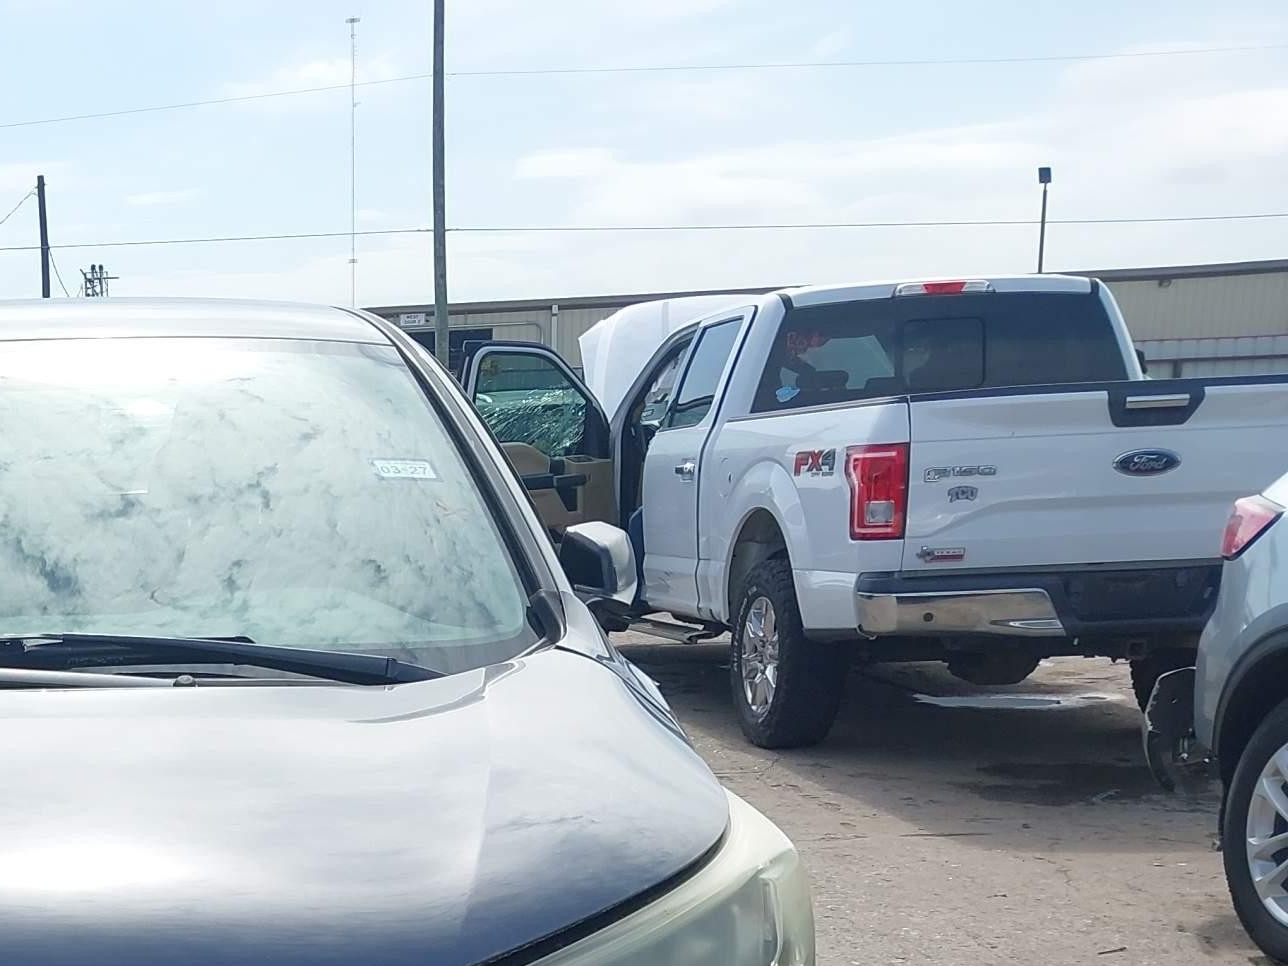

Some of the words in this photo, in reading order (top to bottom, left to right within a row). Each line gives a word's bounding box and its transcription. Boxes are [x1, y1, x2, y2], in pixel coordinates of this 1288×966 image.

[793, 449, 836, 477] FX4
[1129, 454, 1168, 470] Ford
[947, 485, 978, 503] TCU
